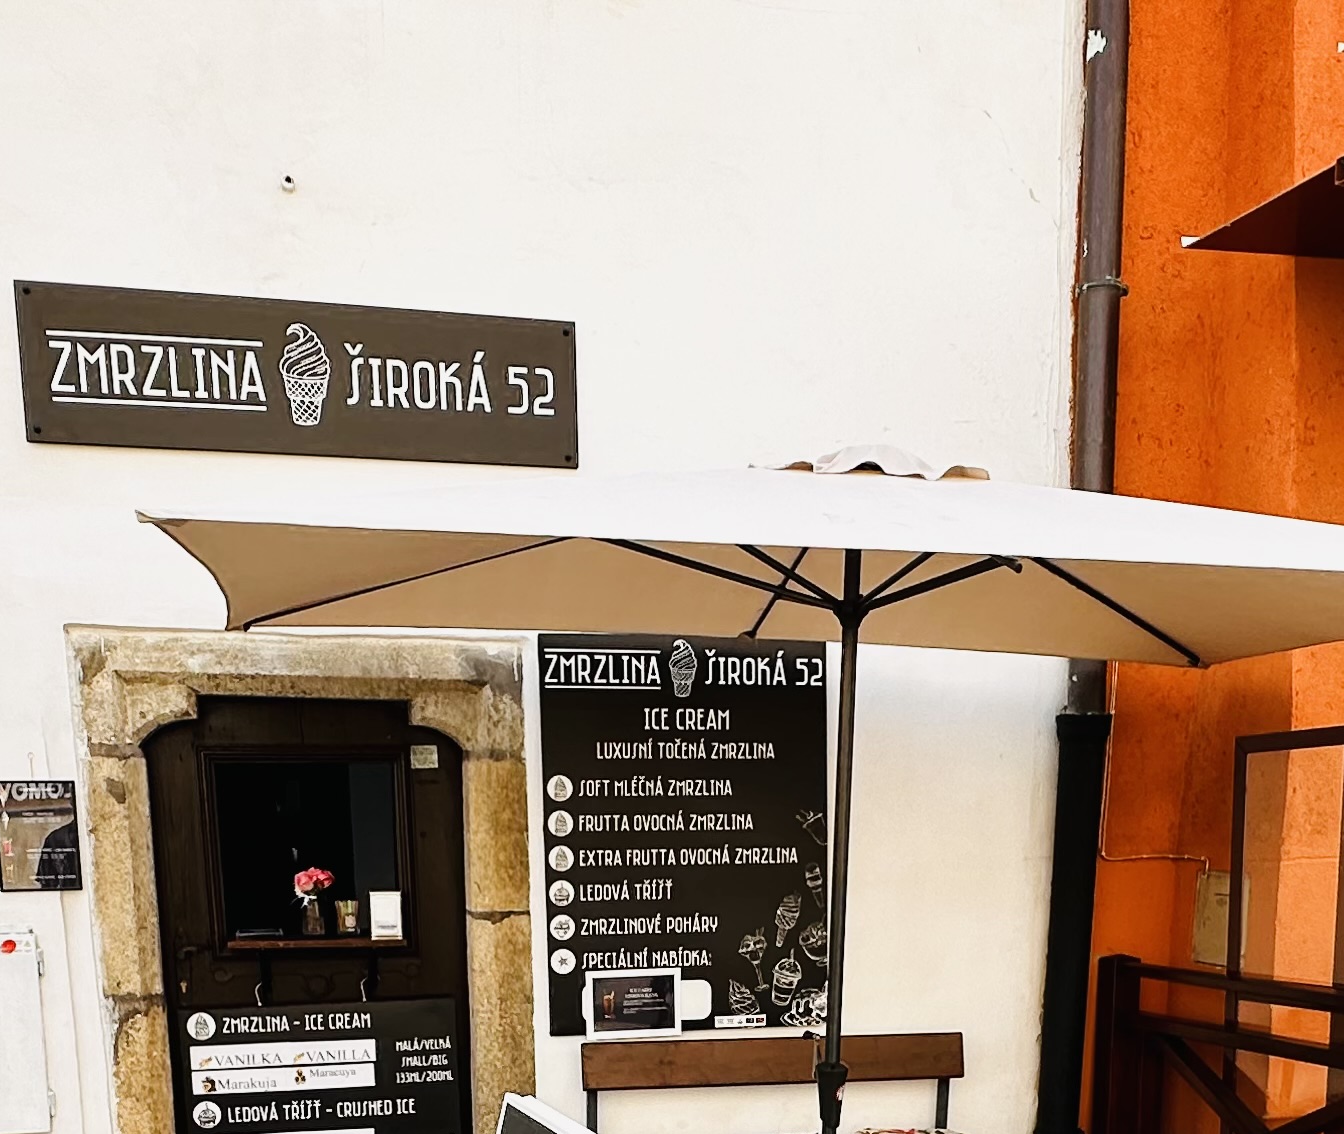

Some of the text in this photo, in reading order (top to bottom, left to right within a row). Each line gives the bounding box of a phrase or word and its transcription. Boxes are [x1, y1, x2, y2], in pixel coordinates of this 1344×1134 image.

[49, 339, 556, 416] ZMRZLINA ŠIROKÁ 52
[544, 649, 823, 687] ZMRZLINA ŠIROKÁ 52
[644, 707, 730, 731] ICE CREAM
[596, 738, 775, 760] LUXUSNÍ TOČENÁ ZMRZLINA
[578, 775, 733, 797] SOFT MLÉČNÁ ZMRZLINA
[579, 810, 754, 832] FRUTTA OVOCNÁ ZMRZLINA
[579, 844, 798, 867] EXTRA FRUTTA OVOCNÁ ZMRZLINA
[579, 878, 673, 902] LEDOVÁ TŘÍŠŤ
[580, 913, 718, 936] ZMRZLINOVÉ POHÁRY
[581, 947, 713, 970] SPECIÁLNÍ NABÍDKA:
[222, 1016, 291, 1034] ZMRZLINA
[304, 1014, 324, 1031] ICE
[328, 1013, 371, 1030] CREAM
[214, 1049, 372, 1067] VANILKA VANILLA
[401, 1054, 449, 1067] SMALL/BIG
[218, 1077, 277, 1093] Marakuja
[227, 1102, 279, 1123] LEDOVÁ
[282, 1099, 322, 1121] TŘÍŠŤ
[336, 1099, 393, 1118] CRUSHED
[396, 1098, 417, 1115] ICE
